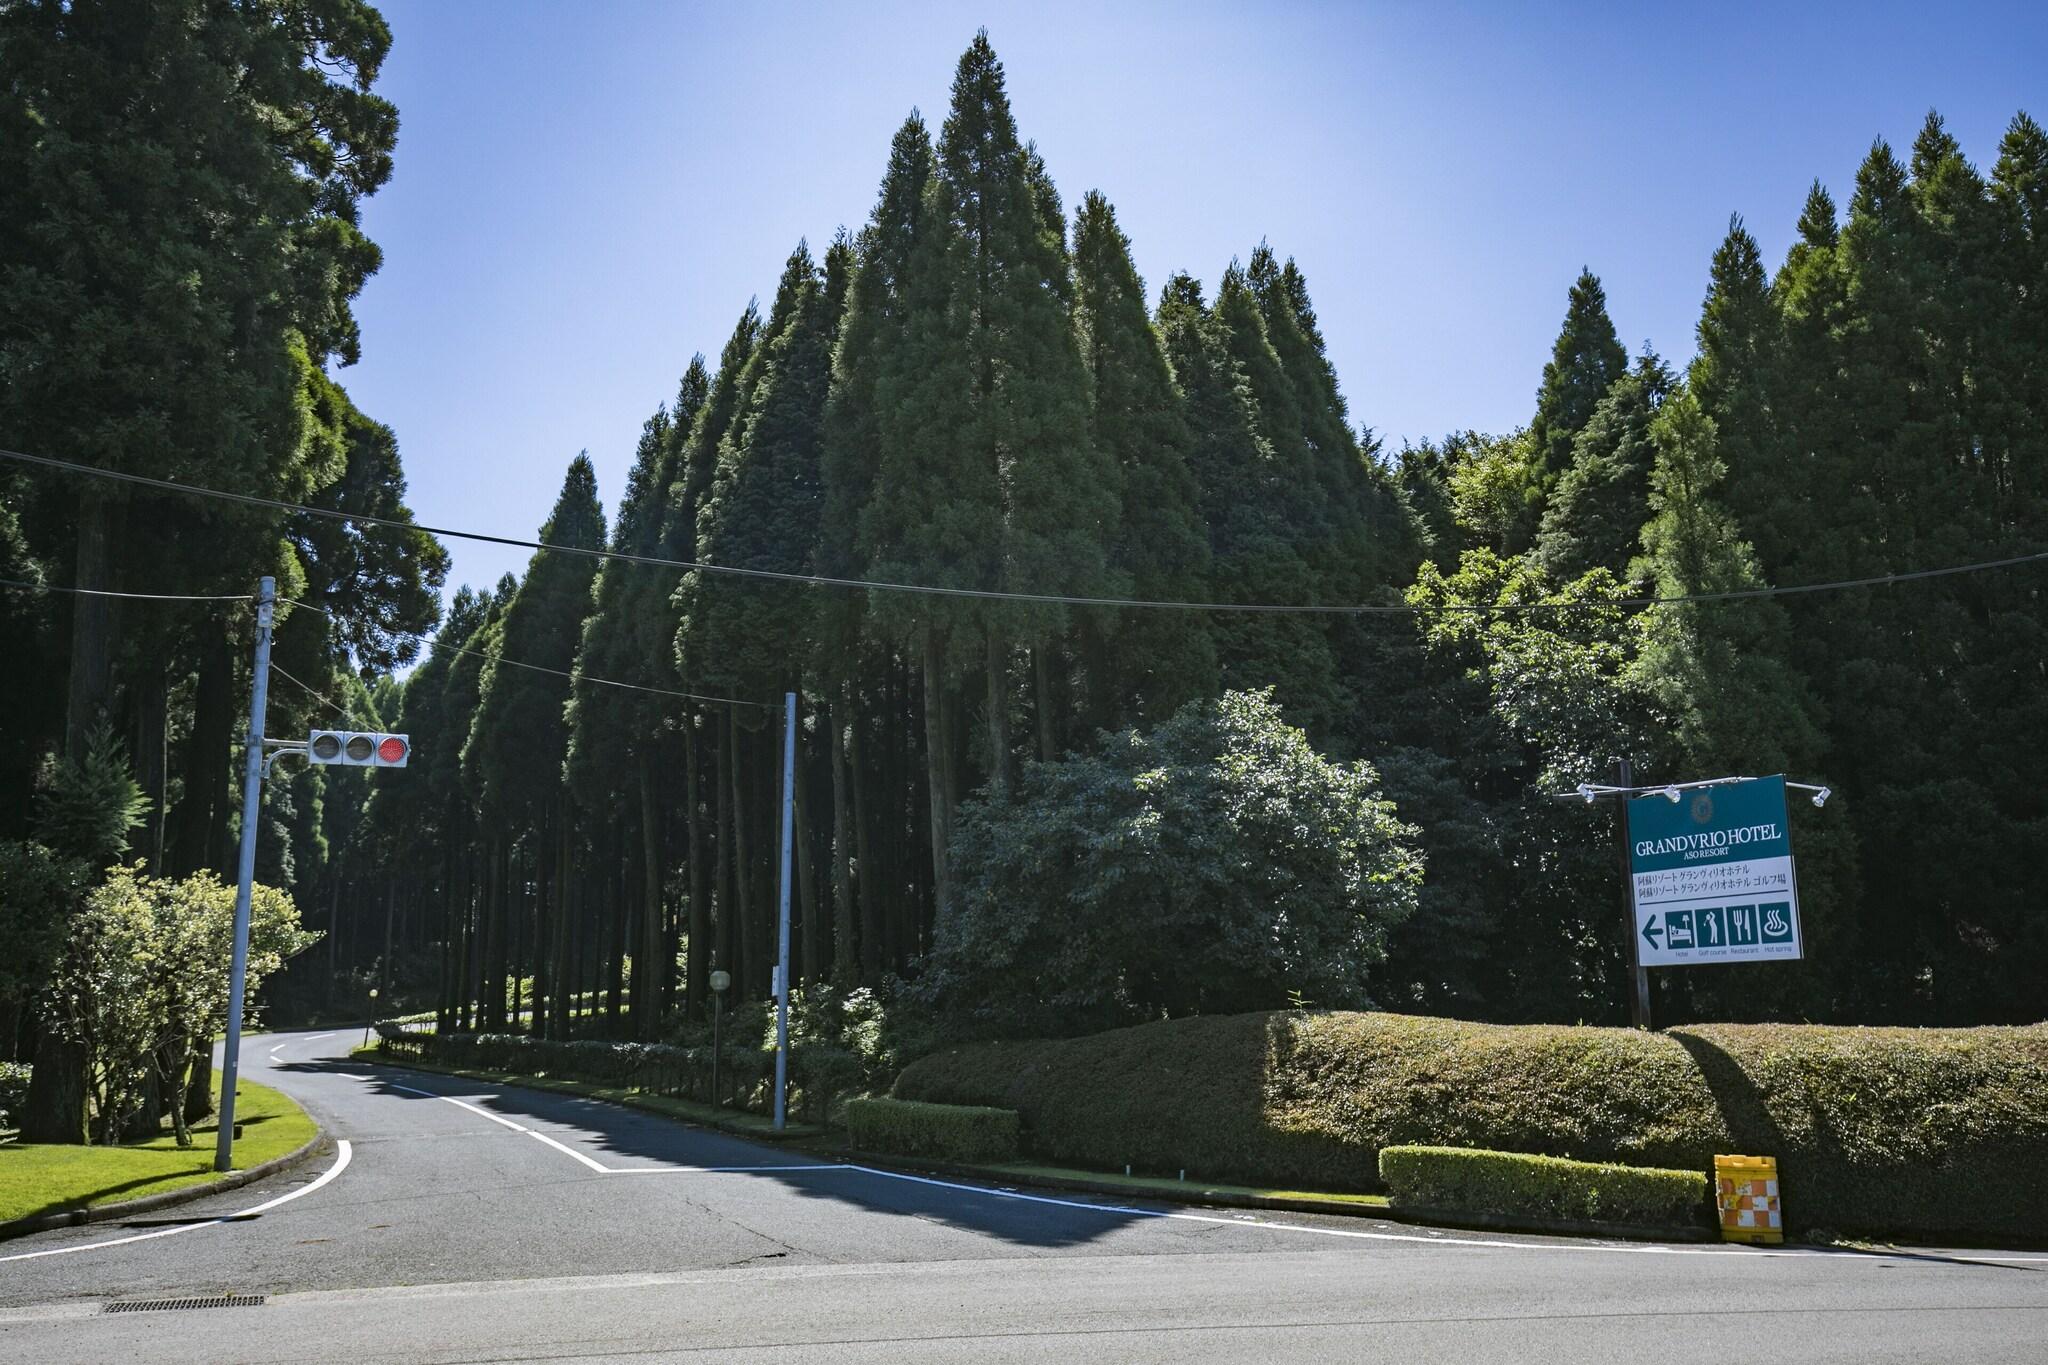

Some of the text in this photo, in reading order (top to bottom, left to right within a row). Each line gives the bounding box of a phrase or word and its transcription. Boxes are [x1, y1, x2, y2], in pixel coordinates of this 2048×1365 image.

[1635, 823, 1782, 857] GRANDVRIO HOTEL
[1683, 846, 1730, 860] ASO RESORT
[1753, 873, 1787, 887] ゴルフ場
